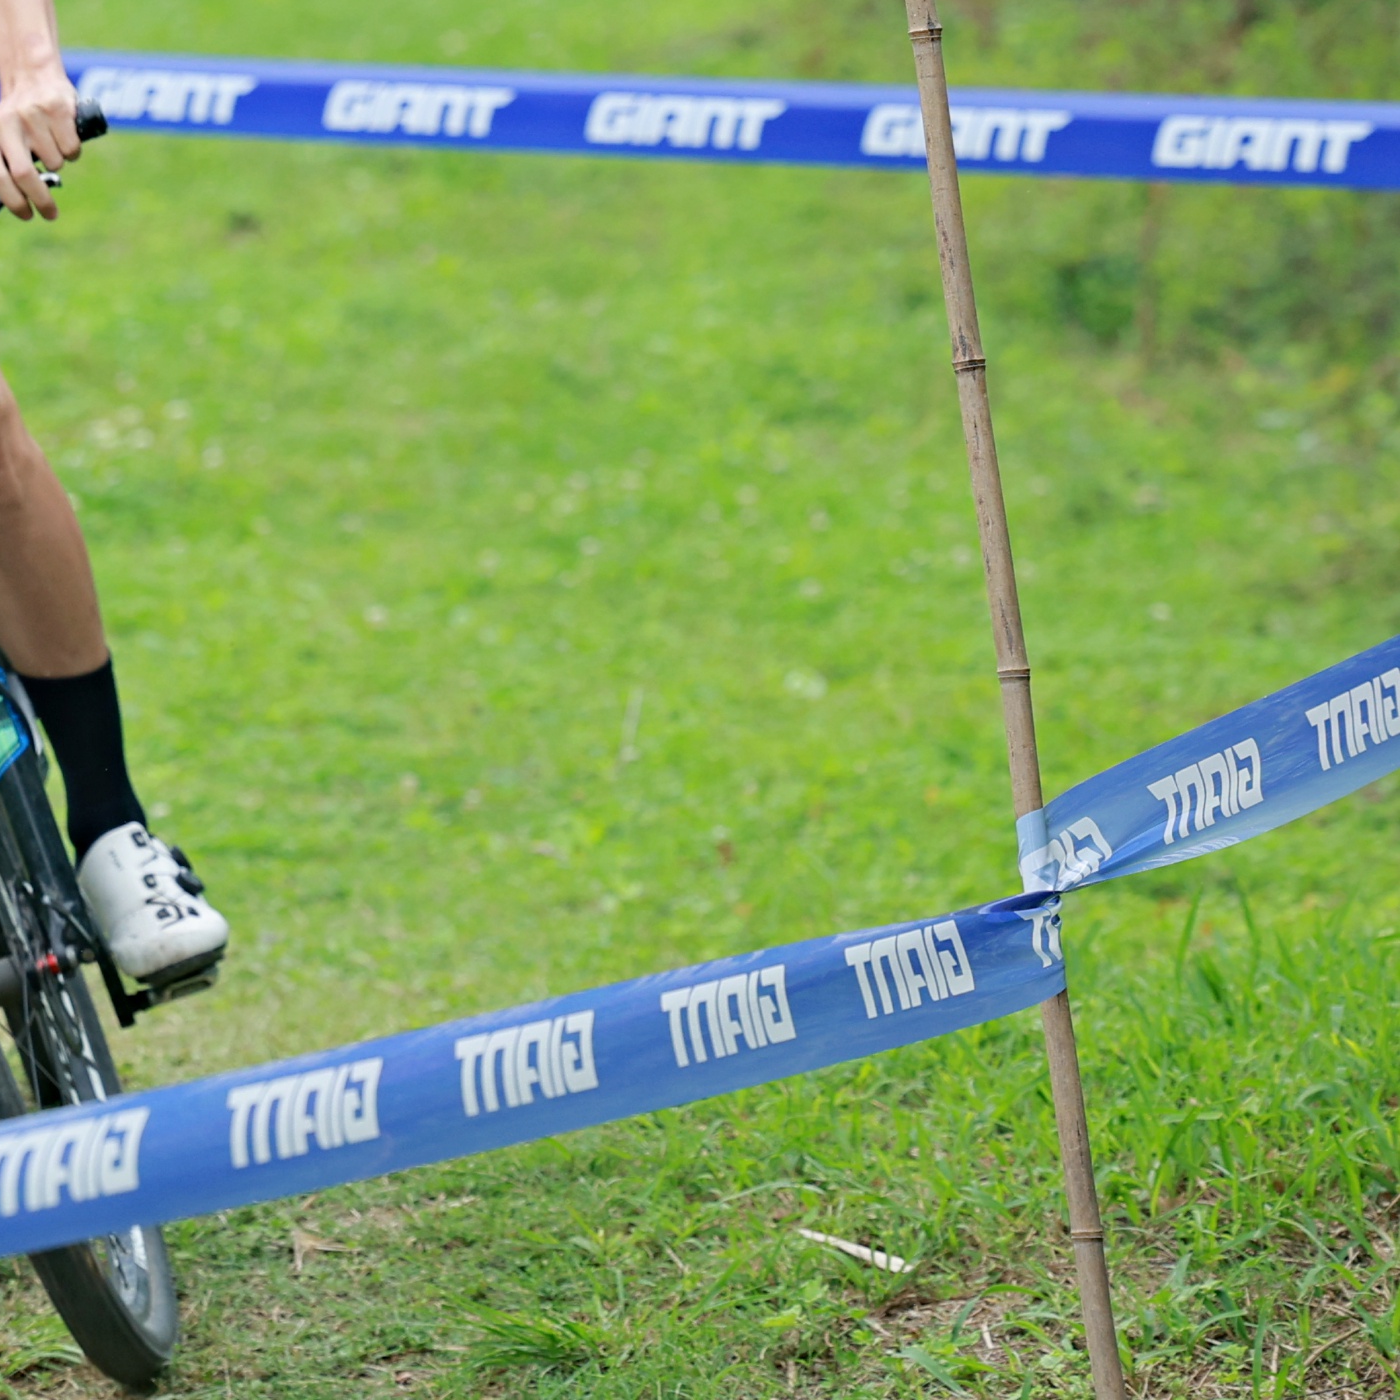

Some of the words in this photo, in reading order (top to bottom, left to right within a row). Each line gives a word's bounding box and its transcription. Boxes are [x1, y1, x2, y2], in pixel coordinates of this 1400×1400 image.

[322, 79, 514, 137] GIANT
[584, 91, 788, 151] GIANT
[1151, 114, 1375, 174] GIANT
